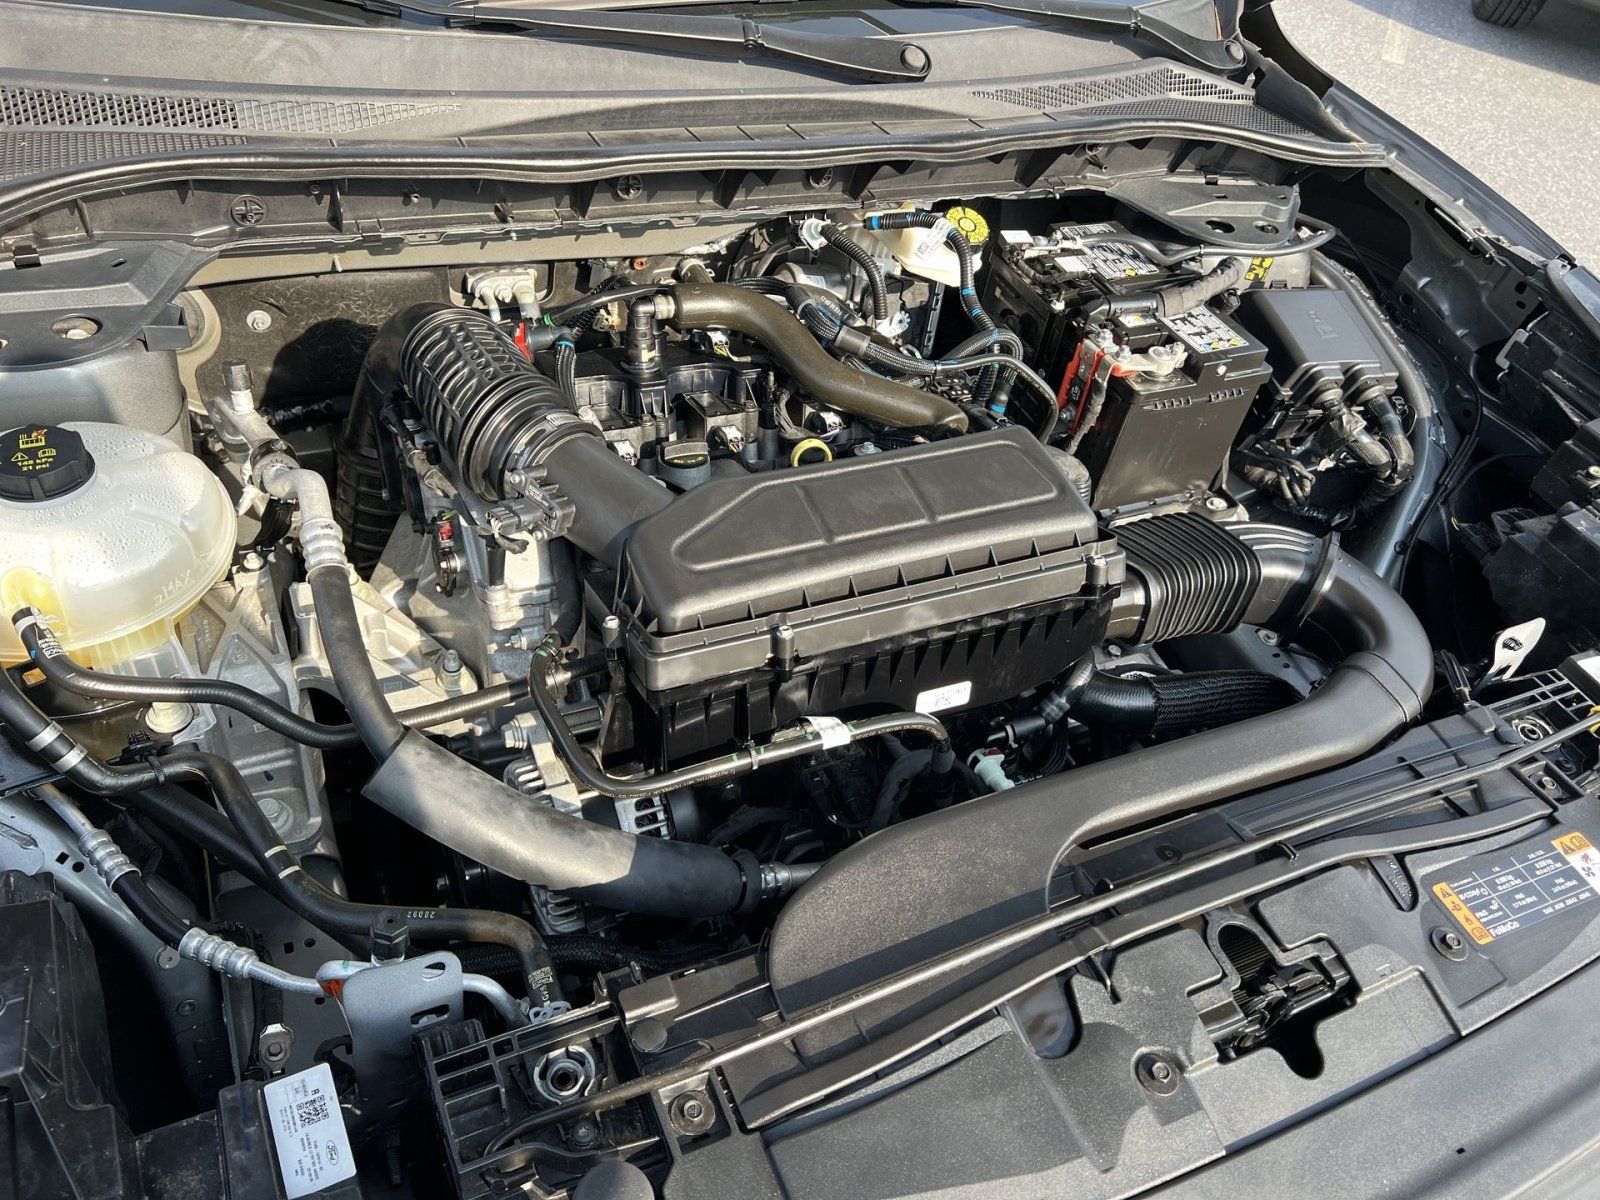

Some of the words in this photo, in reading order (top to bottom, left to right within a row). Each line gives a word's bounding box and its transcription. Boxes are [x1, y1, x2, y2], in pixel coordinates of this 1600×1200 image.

[35, 457, 54, 465] kPa
[1489, 921, 1520, 937] FoMoCo
[326, 1144, 337, 1161] Ford
